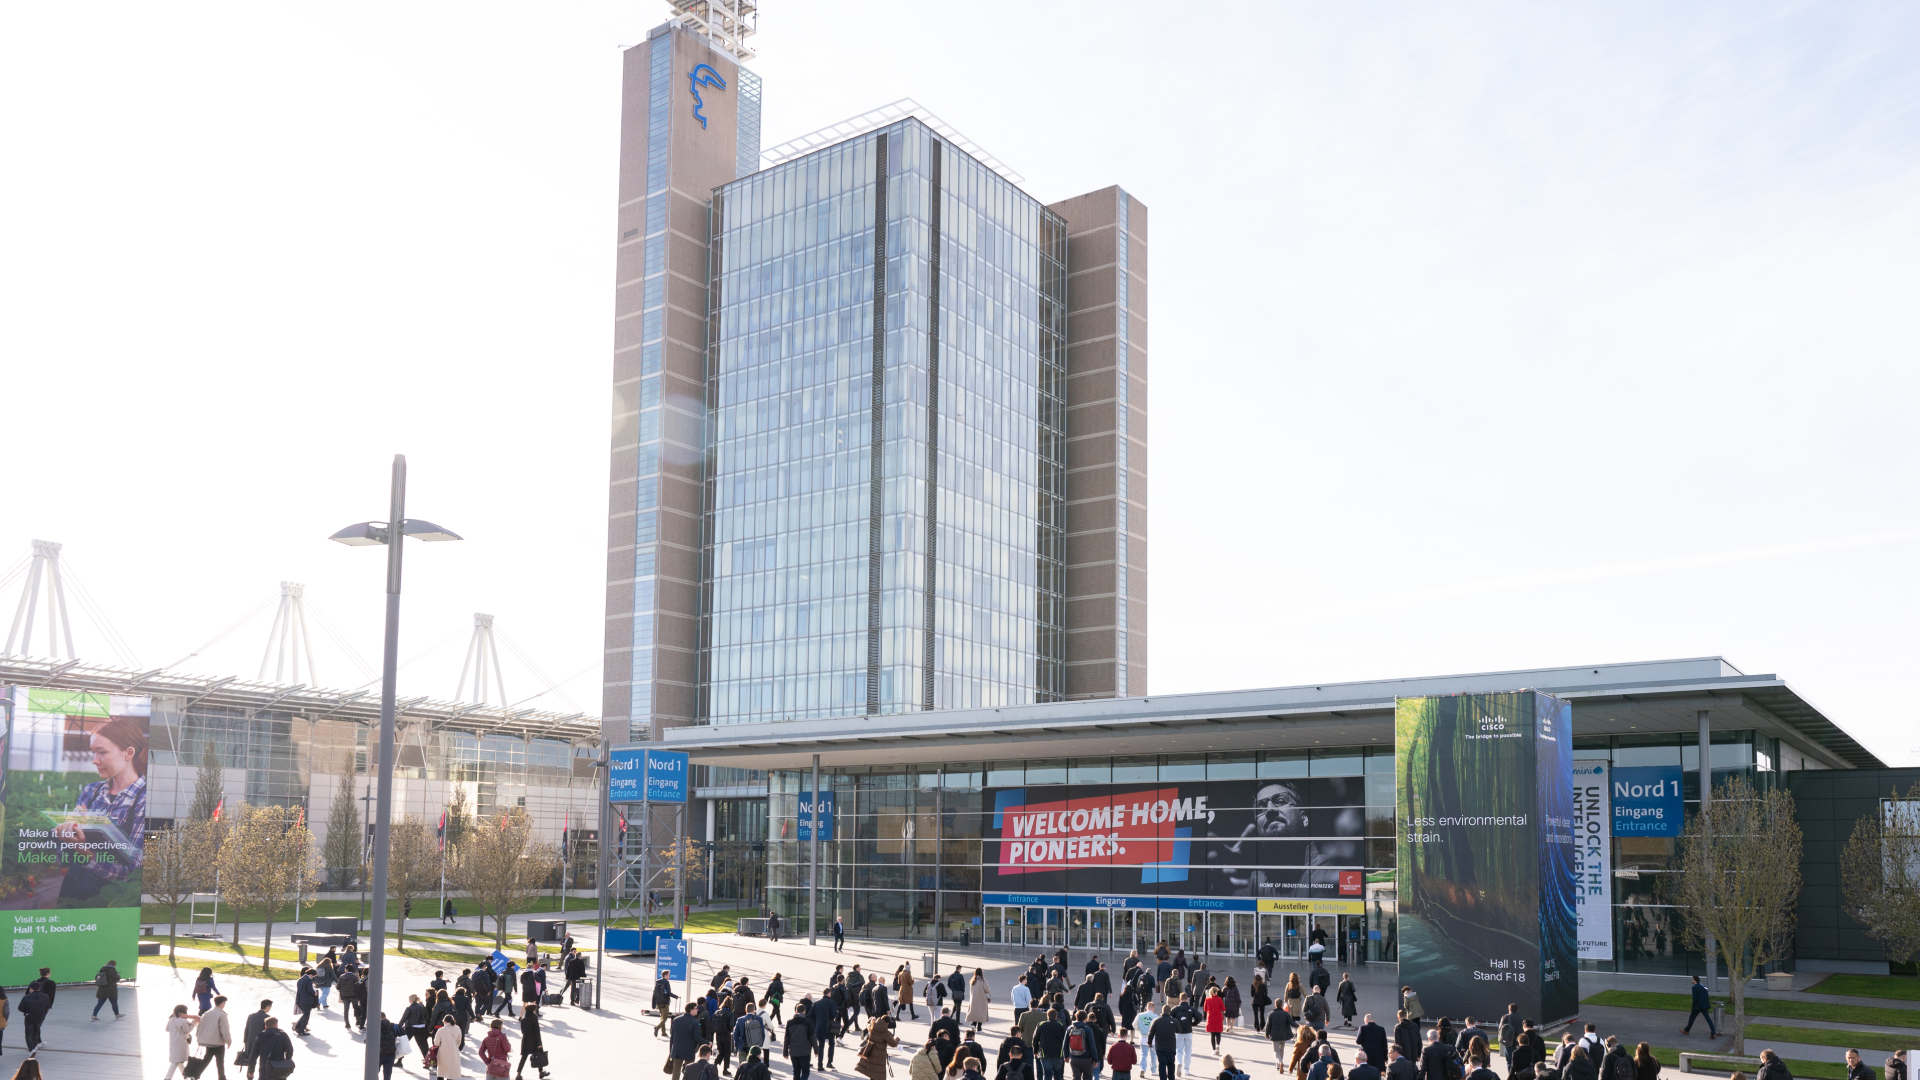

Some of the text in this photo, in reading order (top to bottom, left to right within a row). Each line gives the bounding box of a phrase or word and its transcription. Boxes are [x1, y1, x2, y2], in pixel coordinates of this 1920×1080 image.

[68, 700, 105, 710] Schneider
[1475, 732, 1493, 740] bridge
[634, 758, 639, 770] 1
[649, 758, 681, 771] Nord 1
[610, 778, 637, 788] Eingang
[648, 777, 679, 790] Eingang
[1614, 779, 1665, 798] Nord
[1670, 780, 1679, 797] 1
[610, 789, 639, 798] Entrance
[648, 789, 681, 798] Entrance
[800, 800, 832, 813] Nod 1
[1012, 795, 1216, 838] WELCOME HOME,
[1615, 806, 1664, 819] Eingang
[799, 819, 824, 829] Eingg
[1407, 813, 1527, 827] Less environmental
[1615, 820, 1668, 831] Entrance
[19, 828, 76, 838] Make it for
[1407, 831, 1444, 843] strain.
[18, 840, 131, 851] growth perspectives.
[1573, 787, 1586, 905] INTELLIGENCE
[1586, 786, 1602, 896] UNLOCK THE
[1009, 832, 1126, 864] PIONEERS.
[18, 851, 118, 864] Make it for life.
[1008, 894, 1039, 903] Entrance
[1096, 896, 1126, 907] Eingang
[1188, 898, 1224, 908] Entrance
[1273, 902, 1347, 912] Aussteller Exhibitor
[48, 915, 60, 923] at:
[13, 923, 97, 934] Hall 11, booth C46
[1490, 959, 1526, 969] Hall 15
[1473, 971, 1526, 982] Stand F18
